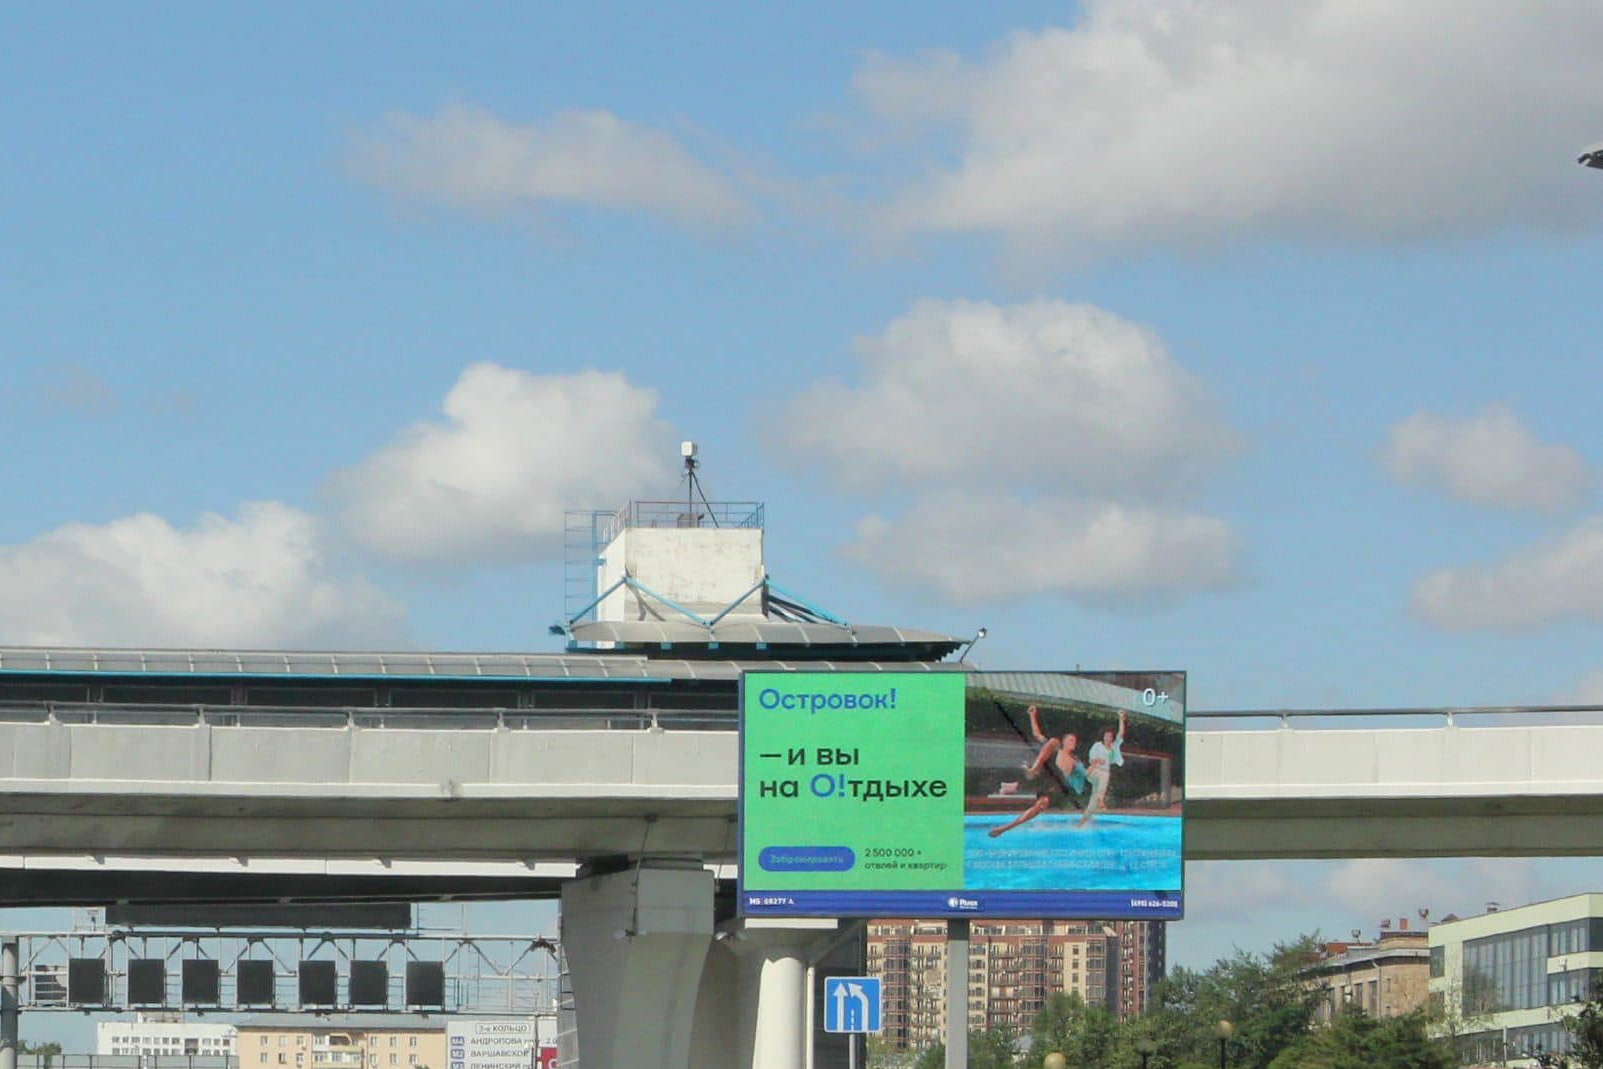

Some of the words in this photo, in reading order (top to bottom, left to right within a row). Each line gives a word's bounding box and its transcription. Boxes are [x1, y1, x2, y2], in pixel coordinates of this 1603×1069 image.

[759, 687, 897, 715] Островок!
[1142, 687, 1169, 707] 0+
[787, 748, 806, 766] и
[816, 748, 860, 766] вы
[759, 780, 799, 798] на
[810, 773, 948, 802] О!тдыхе
[864, 861, 898, 870] отелей
[907, 863, 947, 871] квартир
[492, 1024, 528, 1033] КОЛЬЦО
[470, 1037, 522, 1045] АНДРОПОВА
[470, 1049, 530, 1057] ВАРШАВСКОЕ
[470, 1062, 522, 1069] ЛЕНИНСКИЙ
